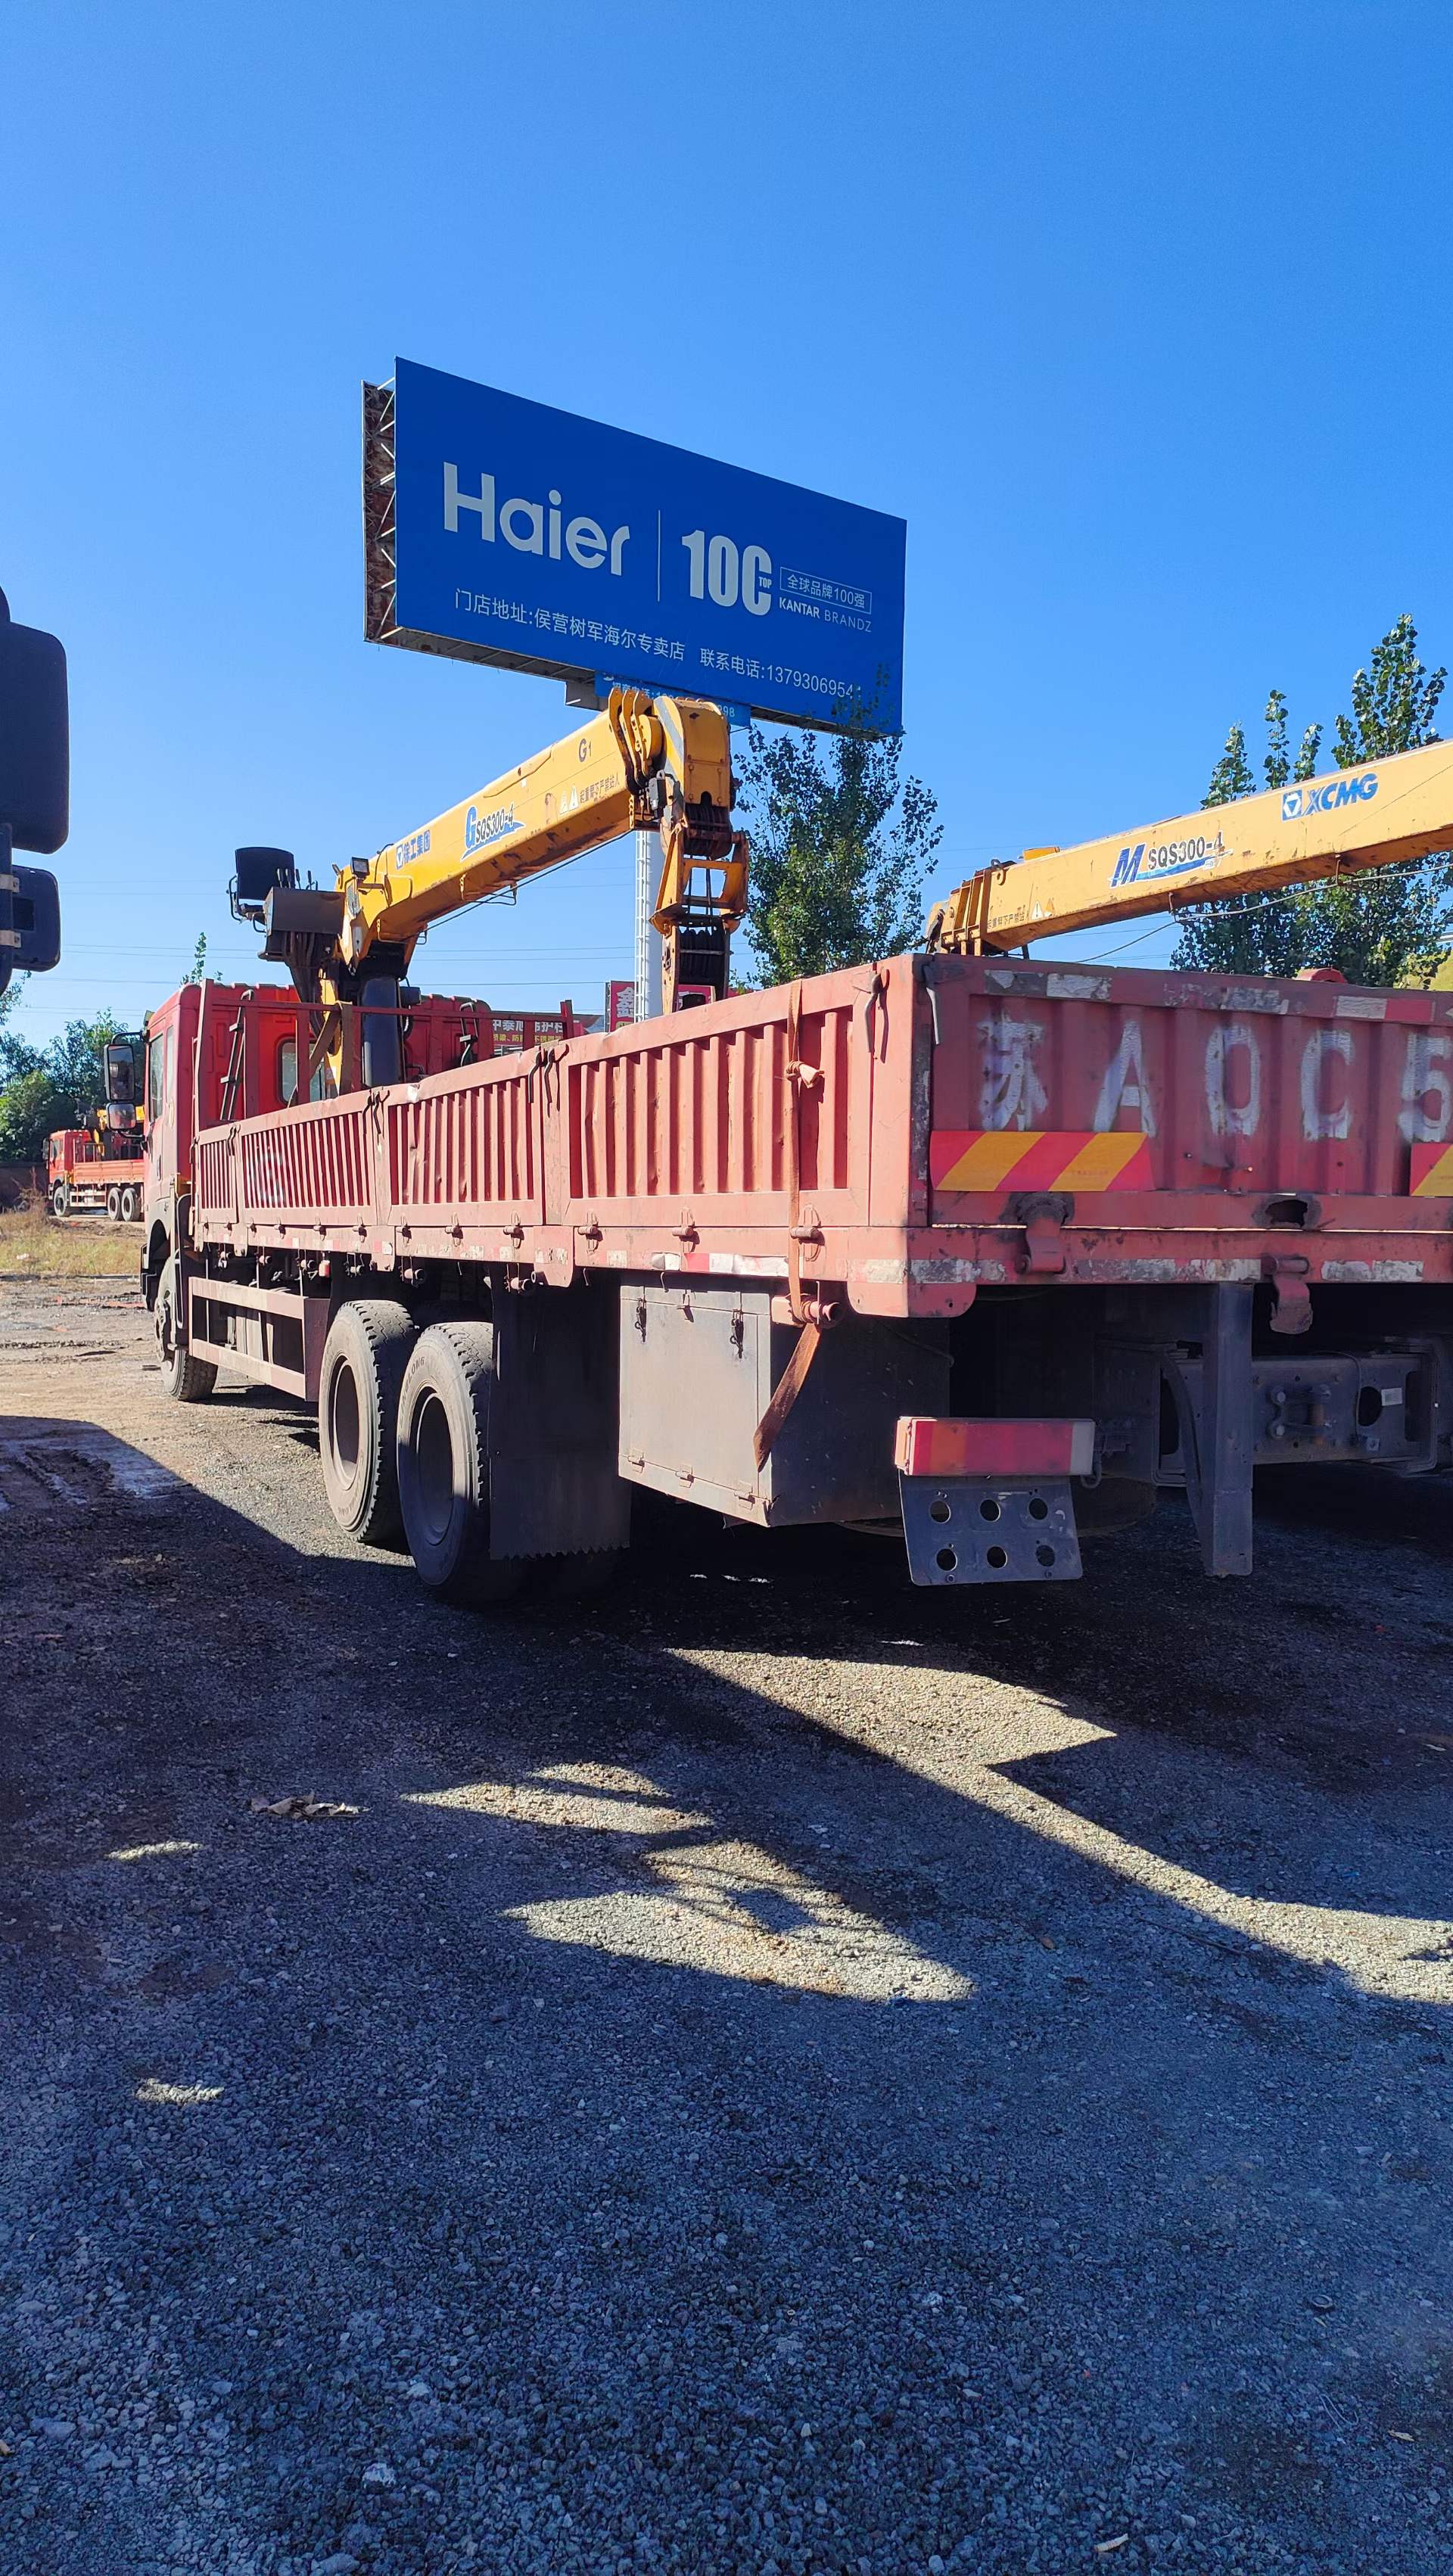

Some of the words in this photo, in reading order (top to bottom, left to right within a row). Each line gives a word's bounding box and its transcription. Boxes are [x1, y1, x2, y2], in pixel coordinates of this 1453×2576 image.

[443, 462, 630, 576] Haier
[759, 576, 772, 589] TOP
[787, 574, 865, 609] 全球品牌100强
[779, 597, 820, 619] KANTAR
[824, 608, 872, 633] BRANDZ
[1302, 773, 1378, 816] XCMG
[403, 829, 430, 863] 徐工集团
